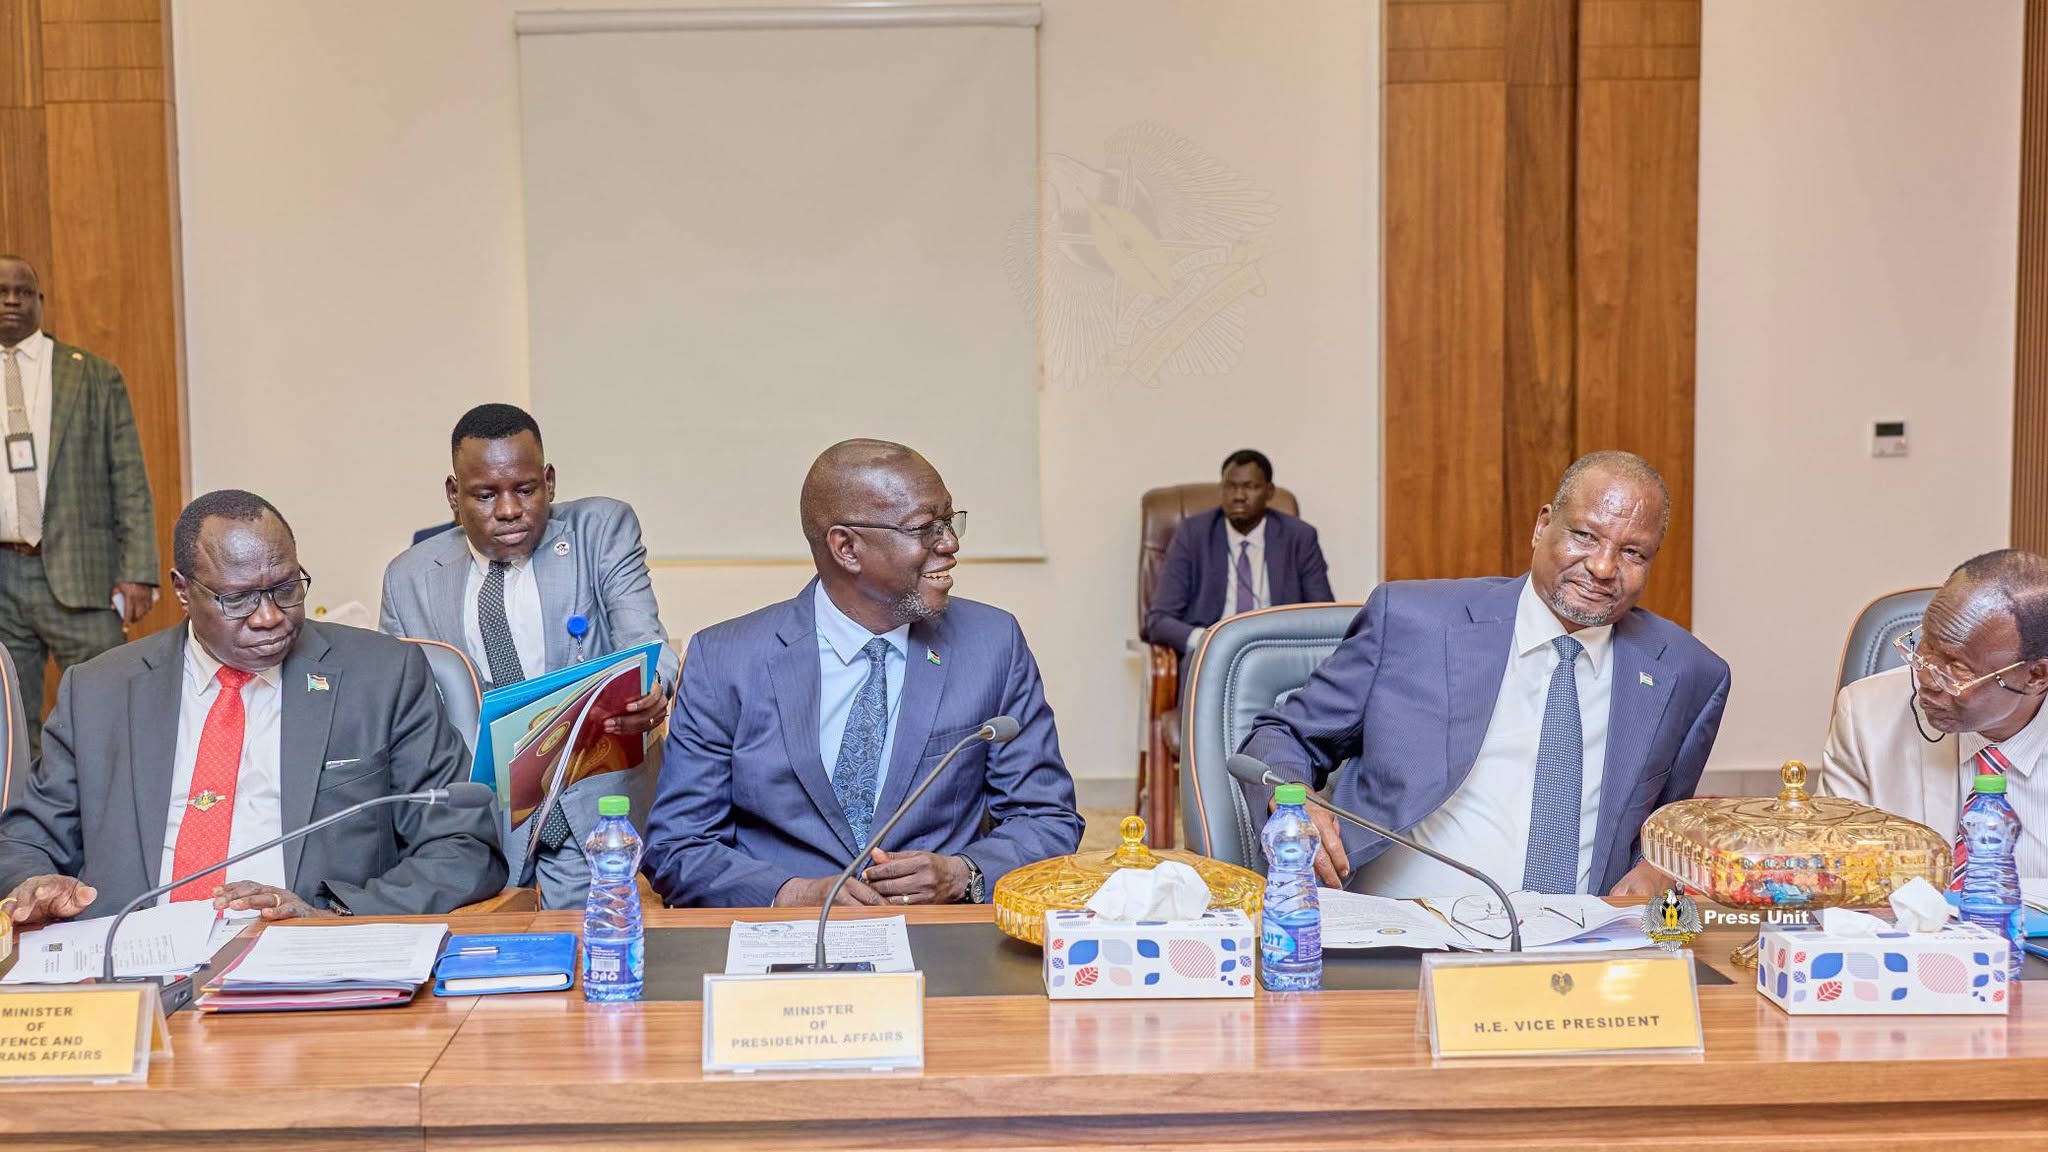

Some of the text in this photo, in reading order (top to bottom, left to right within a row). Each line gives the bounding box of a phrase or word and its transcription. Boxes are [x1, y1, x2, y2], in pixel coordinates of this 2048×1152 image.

[2, 1006, 73, 1017] MINISTER
[783, 1004, 854, 1017] MINISTER
[26, 1021, 45, 1032] OF
[809, 1020, 828, 1030] OF
[1474, 1015, 1660, 1033] H.E. VICE PRESIDENT
[0, 1035, 83, 1047] FENCE AND
[731, 1031, 904, 1048] PRESIDENTIAL AFFAIRS
[41, 1050, 103, 1061] AFFAIRS
